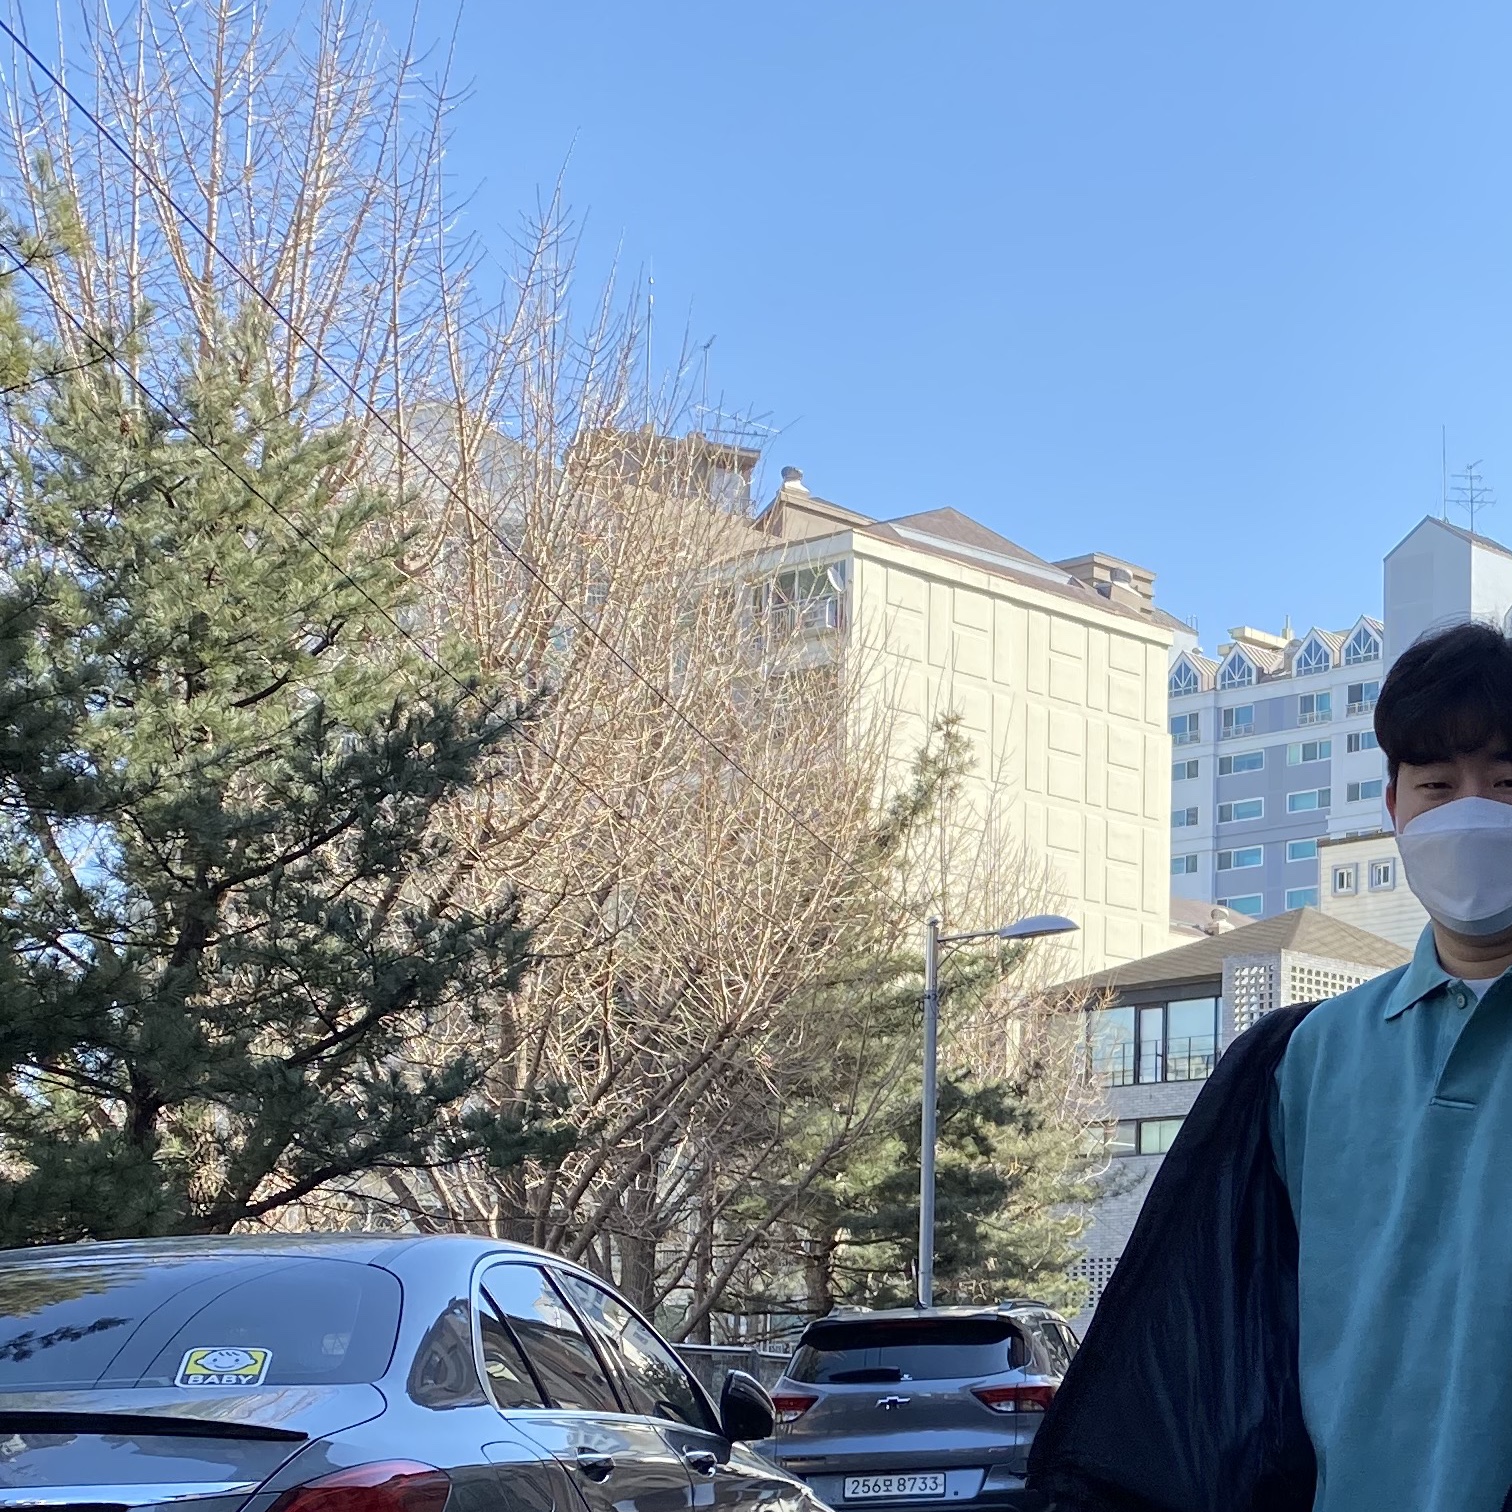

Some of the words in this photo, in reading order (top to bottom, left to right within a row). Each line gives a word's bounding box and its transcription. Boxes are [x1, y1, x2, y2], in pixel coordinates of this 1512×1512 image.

[187, 1374, 254, 1384] BABY
[851, 1479, 892, 1494] 256모
[897, 1476, 938, 1492] 8733
